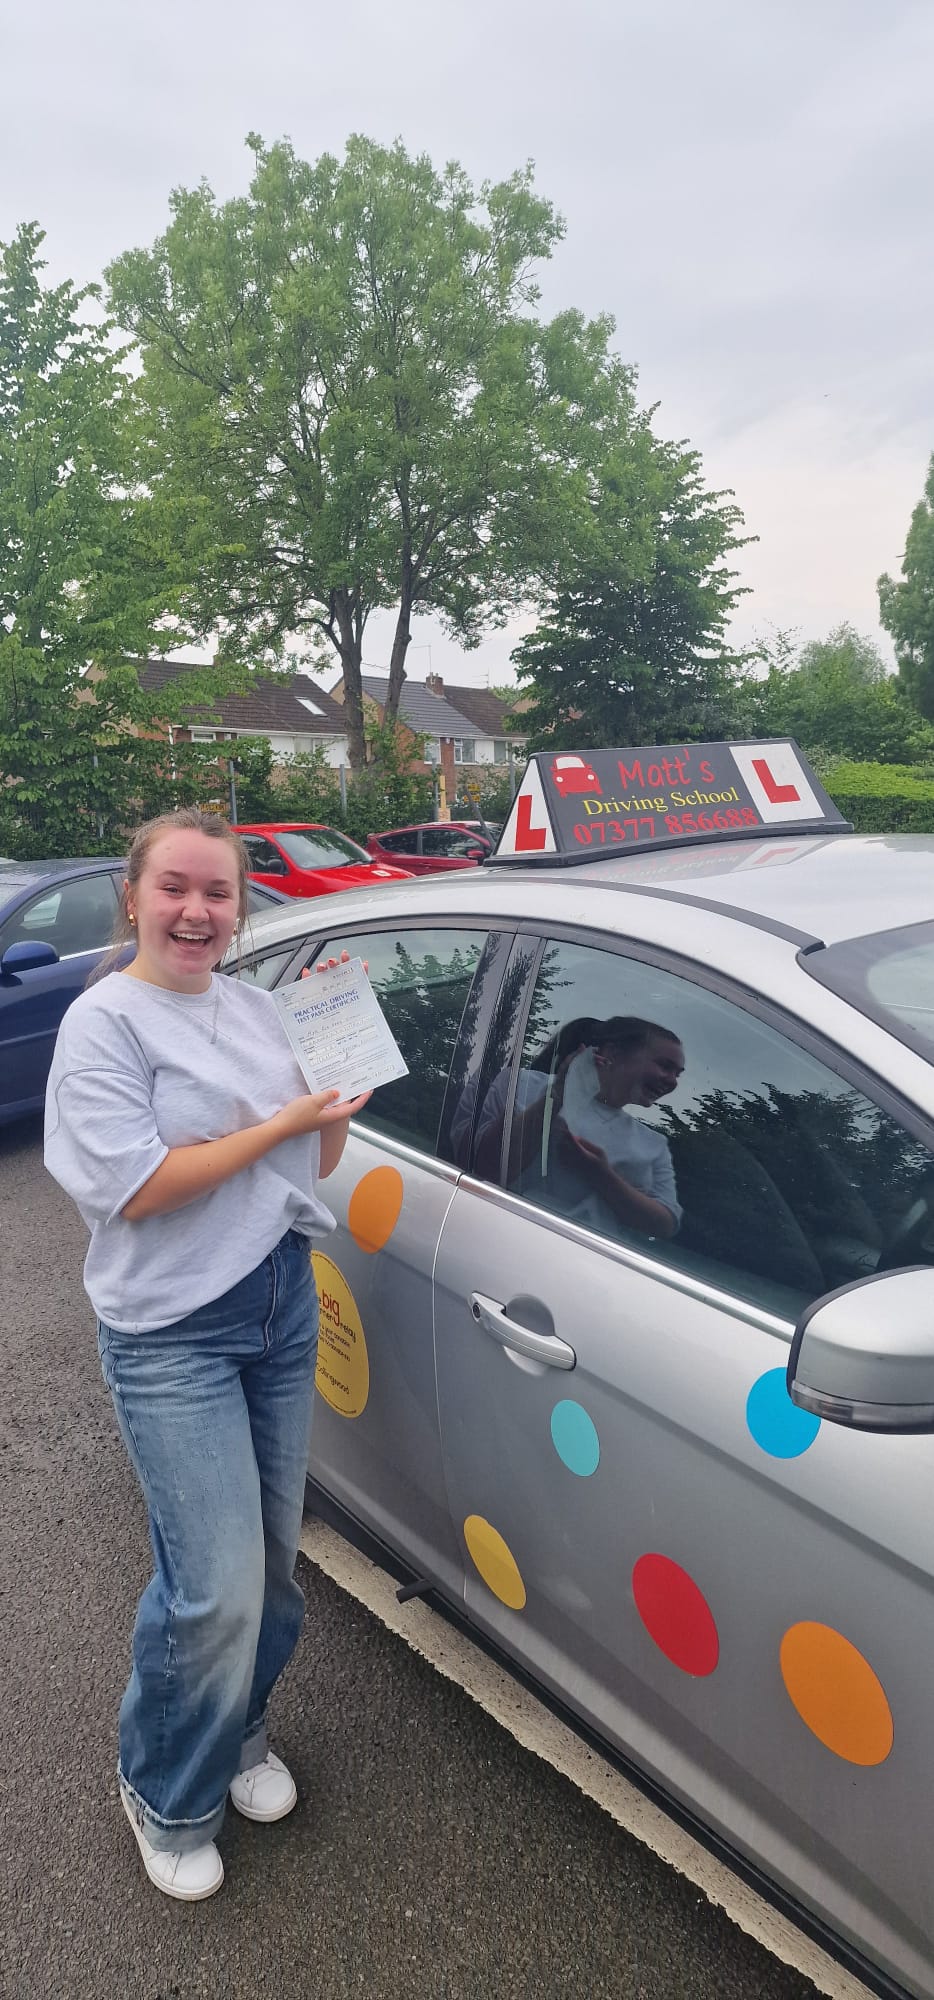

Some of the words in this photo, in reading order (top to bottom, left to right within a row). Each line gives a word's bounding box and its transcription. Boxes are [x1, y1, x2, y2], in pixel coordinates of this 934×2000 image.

[617, 748, 716, 790] Matt's
[751, 759, 801, 804] L
[582, 793, 669, 816] Driving
[669, 786, 741, 808] School
[514, 794, 547, 851] L
[573, 816, 656, 846] 07377
[663, 806, 759, 835] 856688
[293, 1000, 329, 1019] PRACTICAL
[329, 988, 359, 1005] DRIVING
[322, 1289, 340, 1327] big
